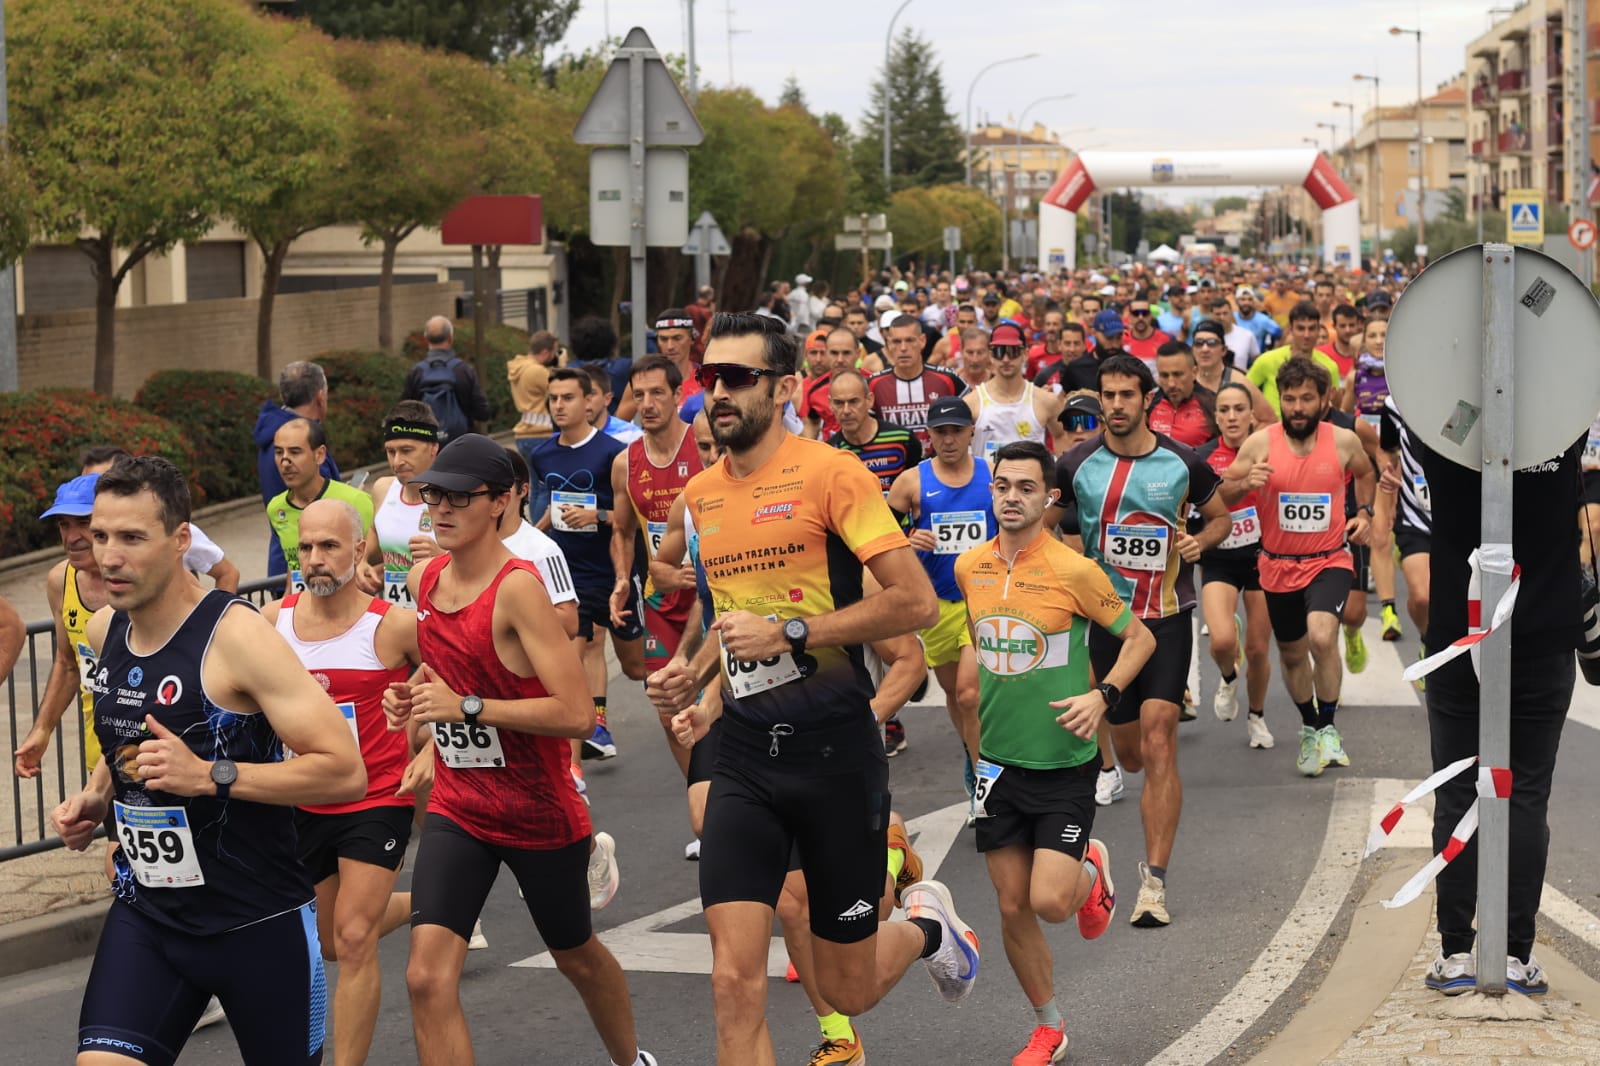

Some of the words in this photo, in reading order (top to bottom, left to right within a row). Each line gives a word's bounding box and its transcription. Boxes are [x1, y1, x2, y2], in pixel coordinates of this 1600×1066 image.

[1284, 505, 1326, 520] 605
[938, 523, 982, 542] 570
[1111, 537, 1161, 556] 389
[704, 552, 743, 568] ESCUELA
[713, 559, 786, 579] SALMANTINA
[978, 636, 1039, 657] ALCER
[435, 721, 492, 750] 556
[122, 827, 184, 864] 359
[82, 1037, 144, 1054] CHARRO
